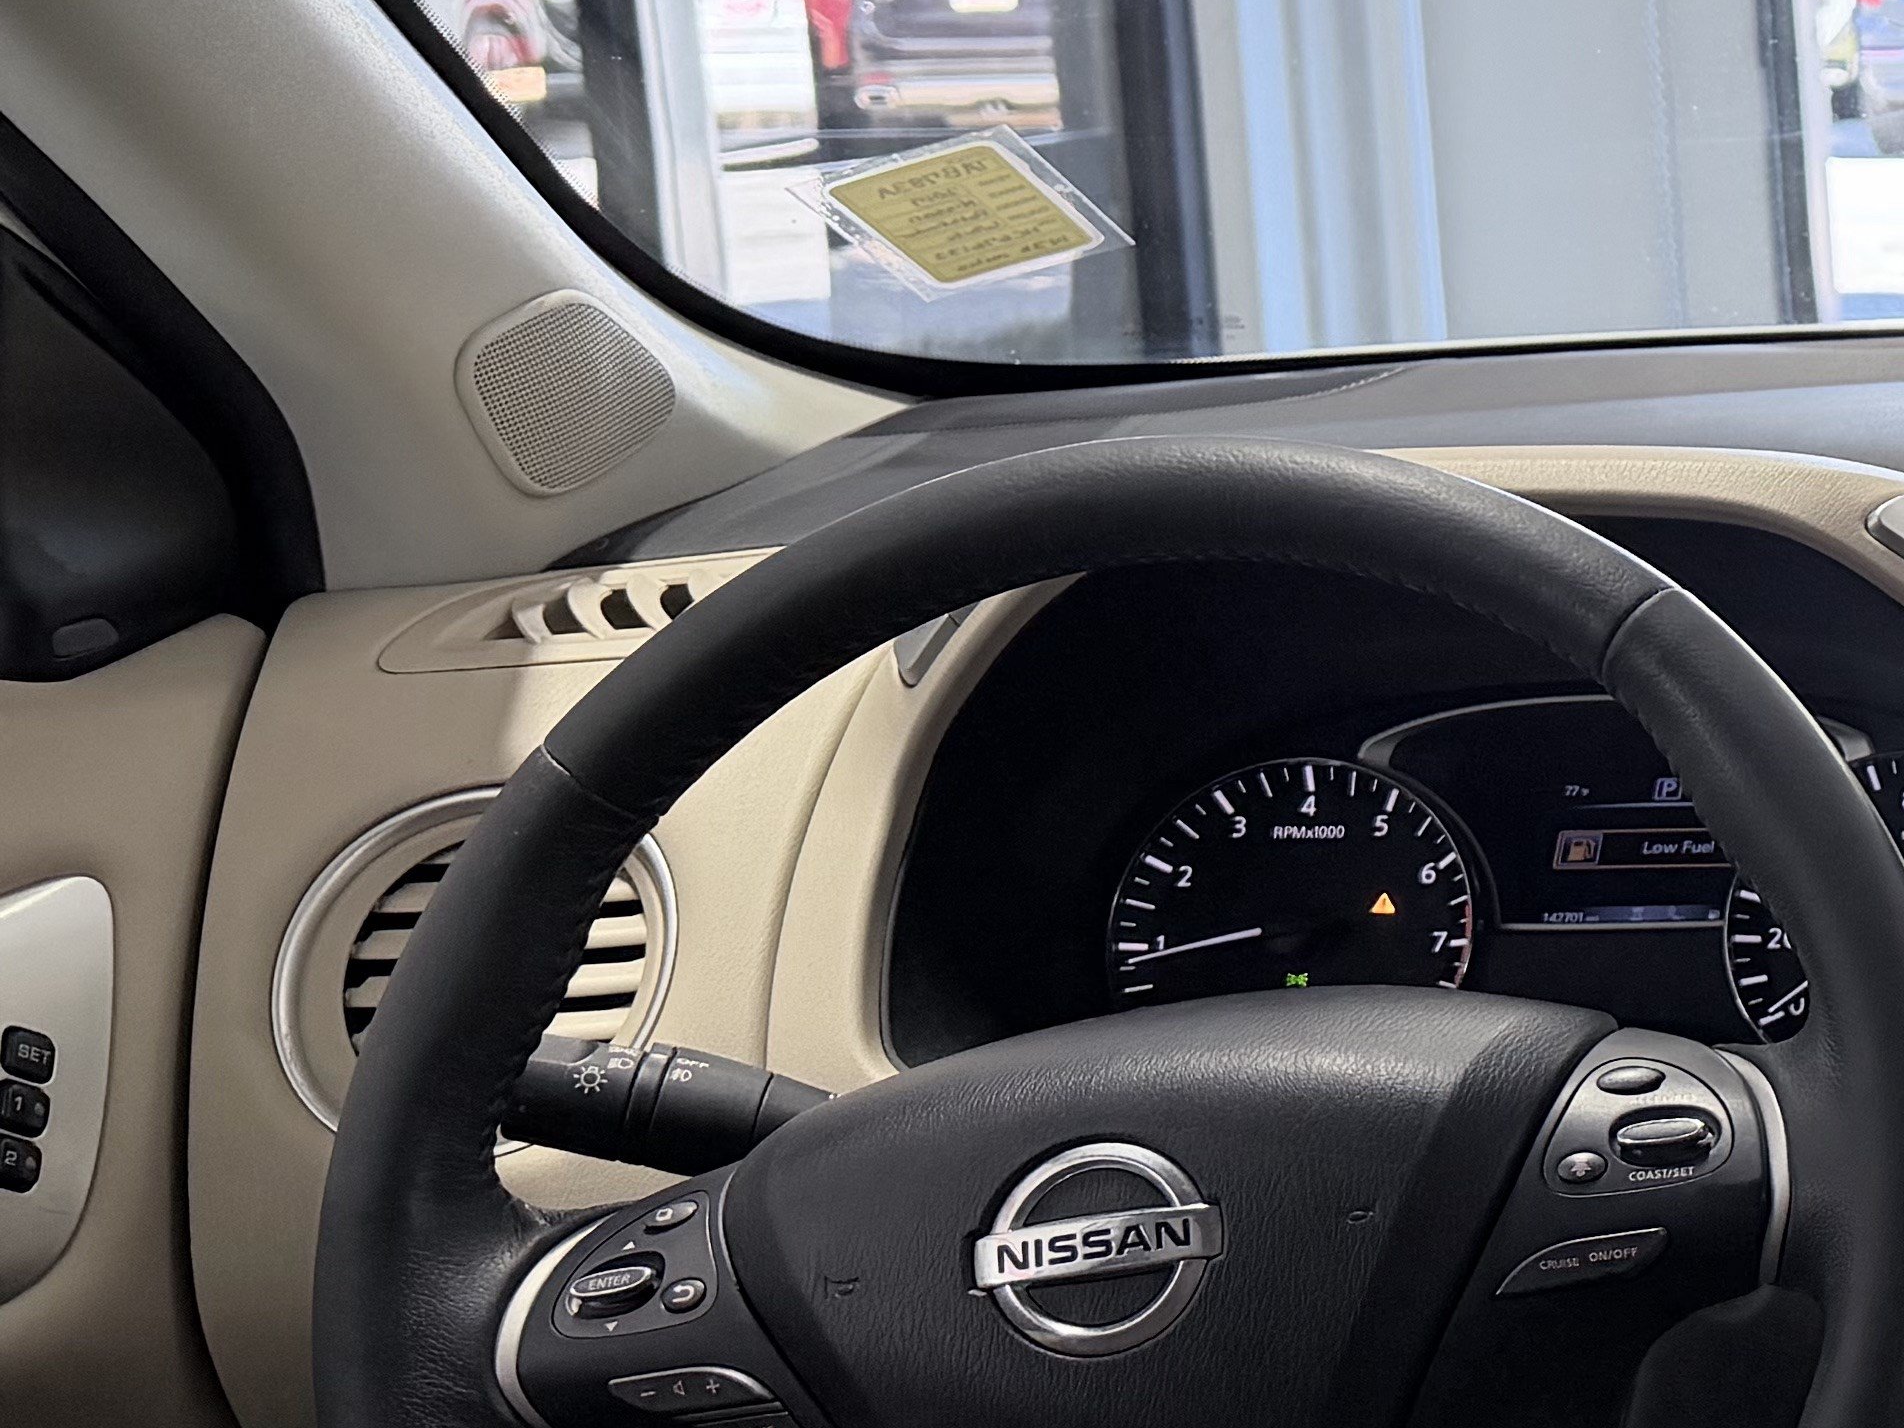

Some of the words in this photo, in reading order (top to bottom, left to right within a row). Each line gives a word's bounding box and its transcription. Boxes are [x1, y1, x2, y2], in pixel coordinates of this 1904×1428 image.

[1661, 779, 1678, 798] P
[1301, 795, 1317, 817] 4
[1232, 816, 1248, 839] 3
[1272, 824, 1346, 840] RPMx1000
[1373, 815, 1389, 837] 5
[1642, 841, 1678, 855] Low
[1682, 840, 1716, 855] Fuel
[1176, 866, 1192, 888] 2
[1420, 862, 1437, 884] 6
[1156, 934, 1166, 950] 1
[1431, 931, 1449, 953] 7
[17, 1043, 52, 1066] SET
[13, 1095, 22, 1112] 1
[4, 1150, 18, 1167] 2
[1628, 1166, 1695, 1183] COAST/SET
[997, 1218, 1191, 1273] NISSAN
[1539, 1256, 1580, 1272] CRUISE
[1589, 1246, 1638, 1263] ON/OFF
[587, 1272, 631, 1290] ENTER
